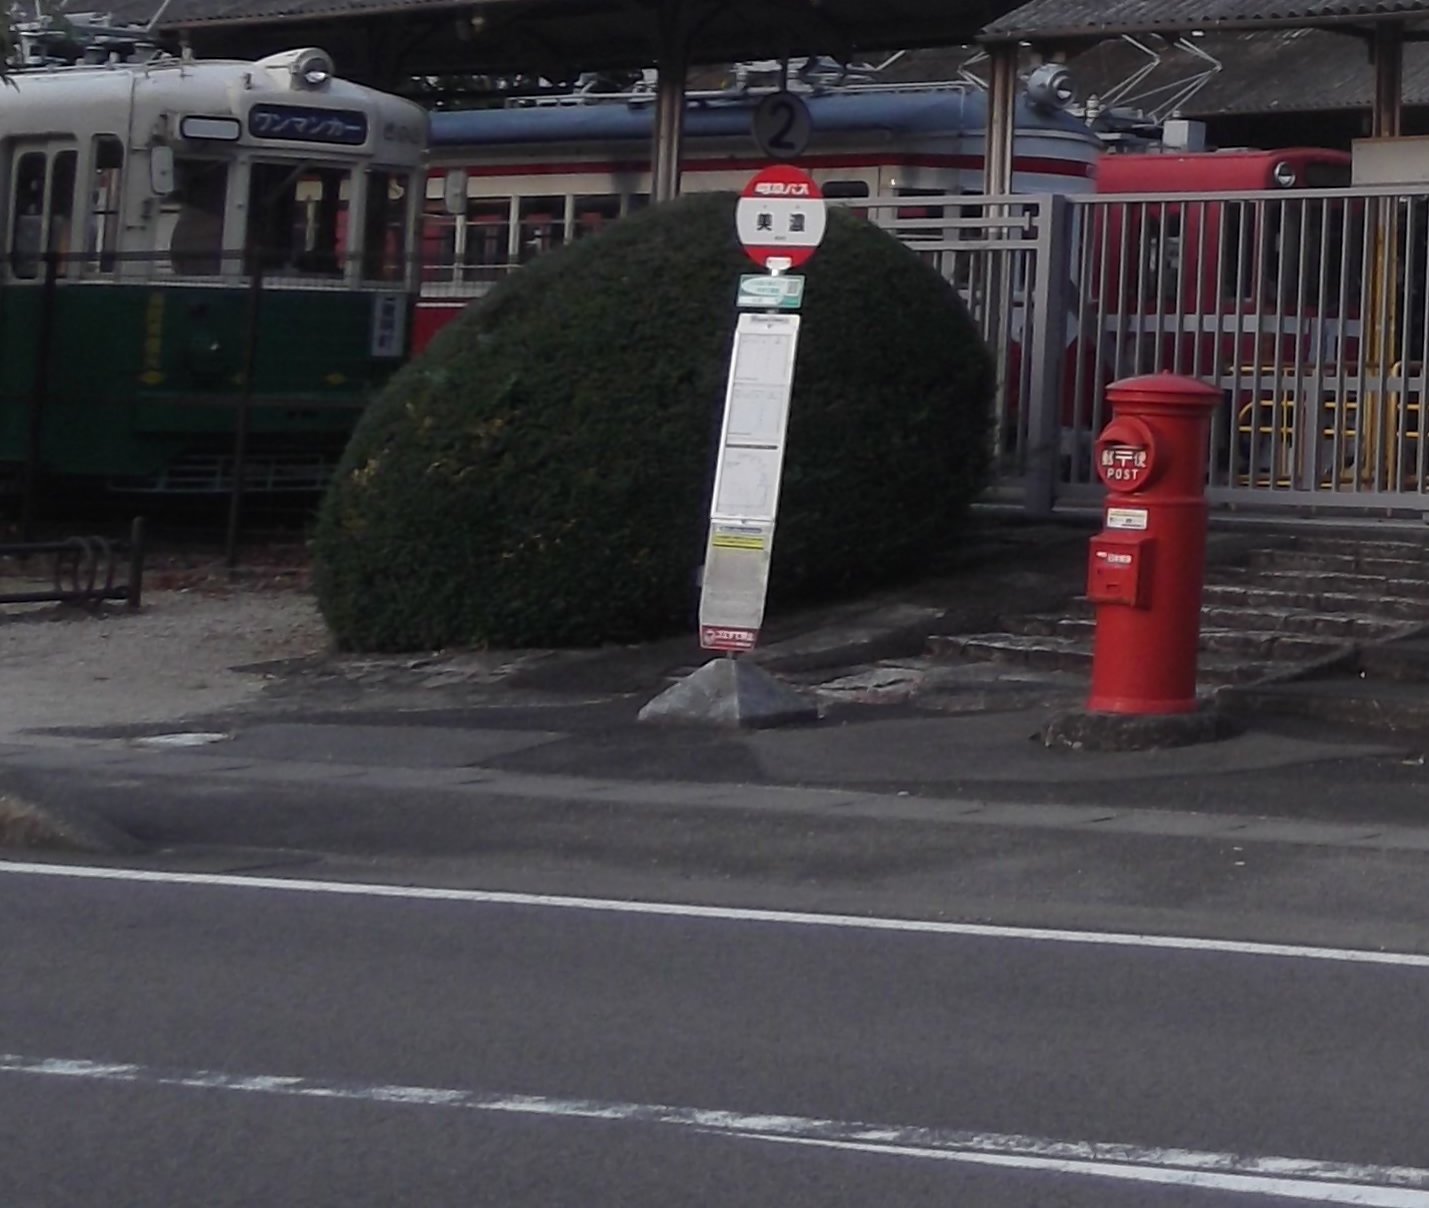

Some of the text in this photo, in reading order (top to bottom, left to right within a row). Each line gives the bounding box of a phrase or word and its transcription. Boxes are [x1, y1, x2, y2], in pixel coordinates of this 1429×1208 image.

[254, 111, 361, 136] ワンマンカー
[768, 100, 796, 150] 2
[1106, 467, 1139, 481] POST
